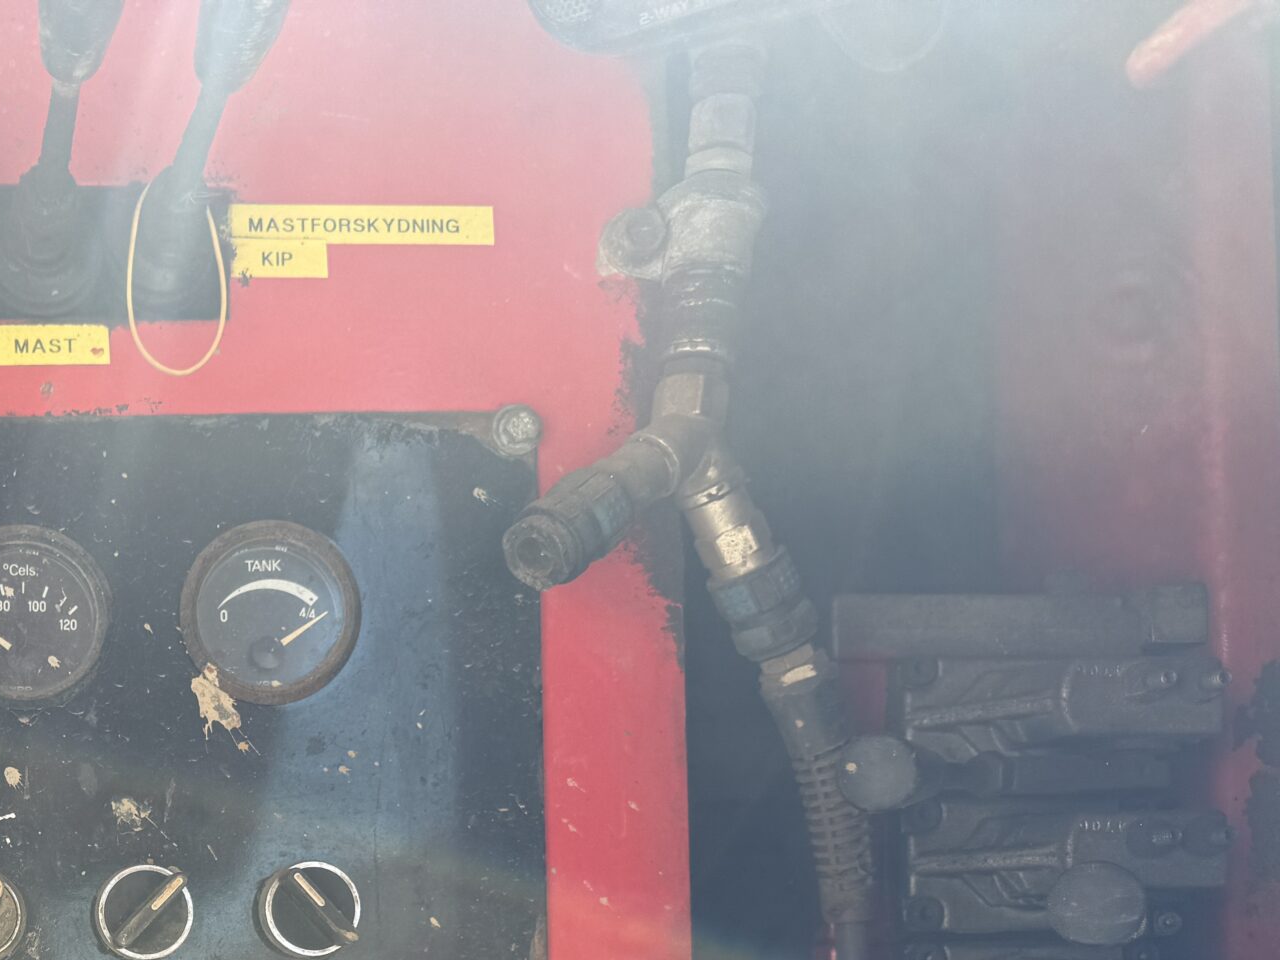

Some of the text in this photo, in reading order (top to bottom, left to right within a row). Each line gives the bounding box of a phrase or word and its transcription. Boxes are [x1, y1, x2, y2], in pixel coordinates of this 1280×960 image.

[248, 217, 461, 234] MASTFORSKYDNING
[261, 251, 293, 267] KIP
[14, 337, 77, 354] MAST
[245, 559, 281, 572] TANK
[28, 601, 47, 612] 100
[220, 610, 228, 622] 0
[59, 619, 78, 631] 120
